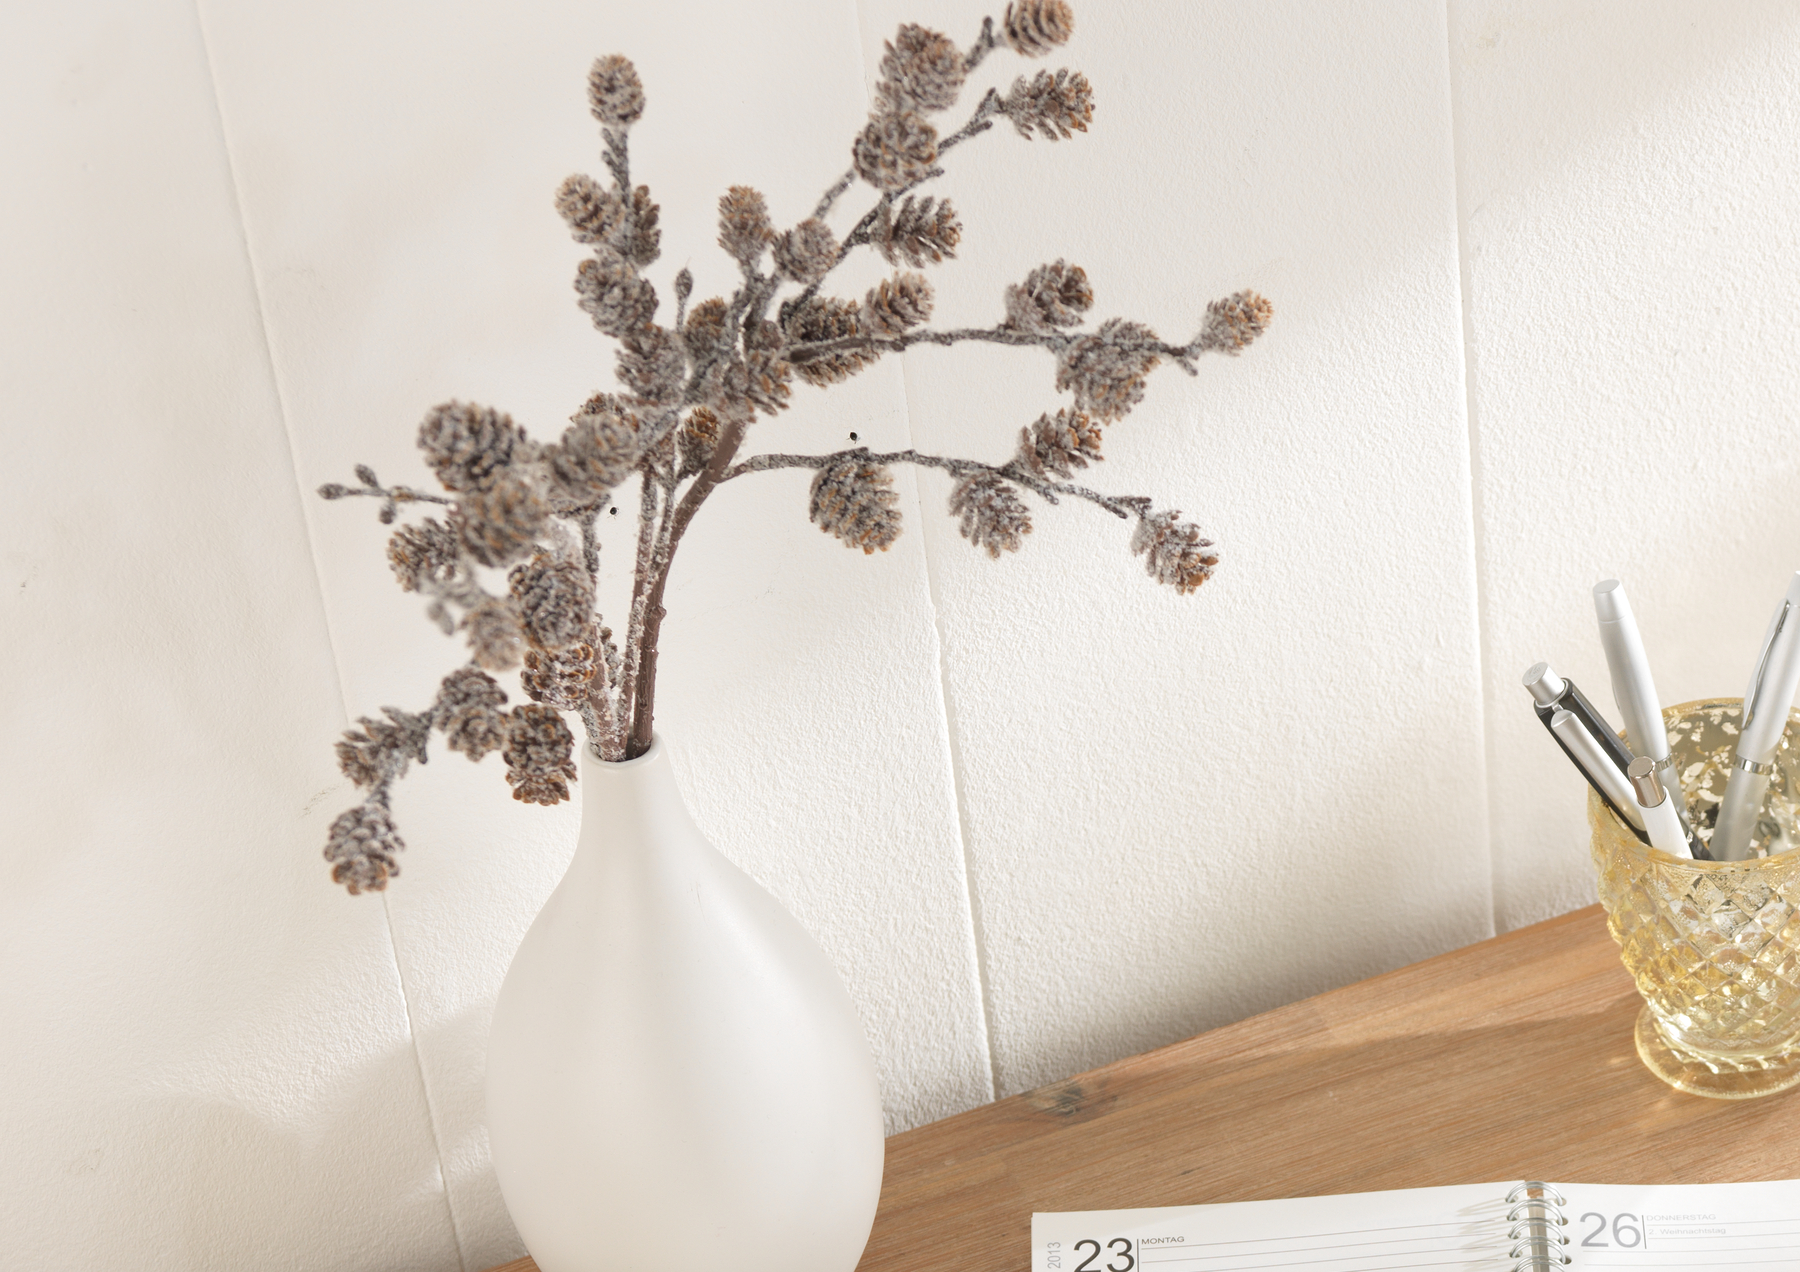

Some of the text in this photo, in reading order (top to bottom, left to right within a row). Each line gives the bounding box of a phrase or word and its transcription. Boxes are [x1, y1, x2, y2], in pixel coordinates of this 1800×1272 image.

[1579, 1212, 1641, 1248] 26
[1660, 1227, 1726, 1235] Weihnachtstag
[1141, 1236, 1185, 1245] MONTAG
[1047, 1242, 1061, 1269] 2013
